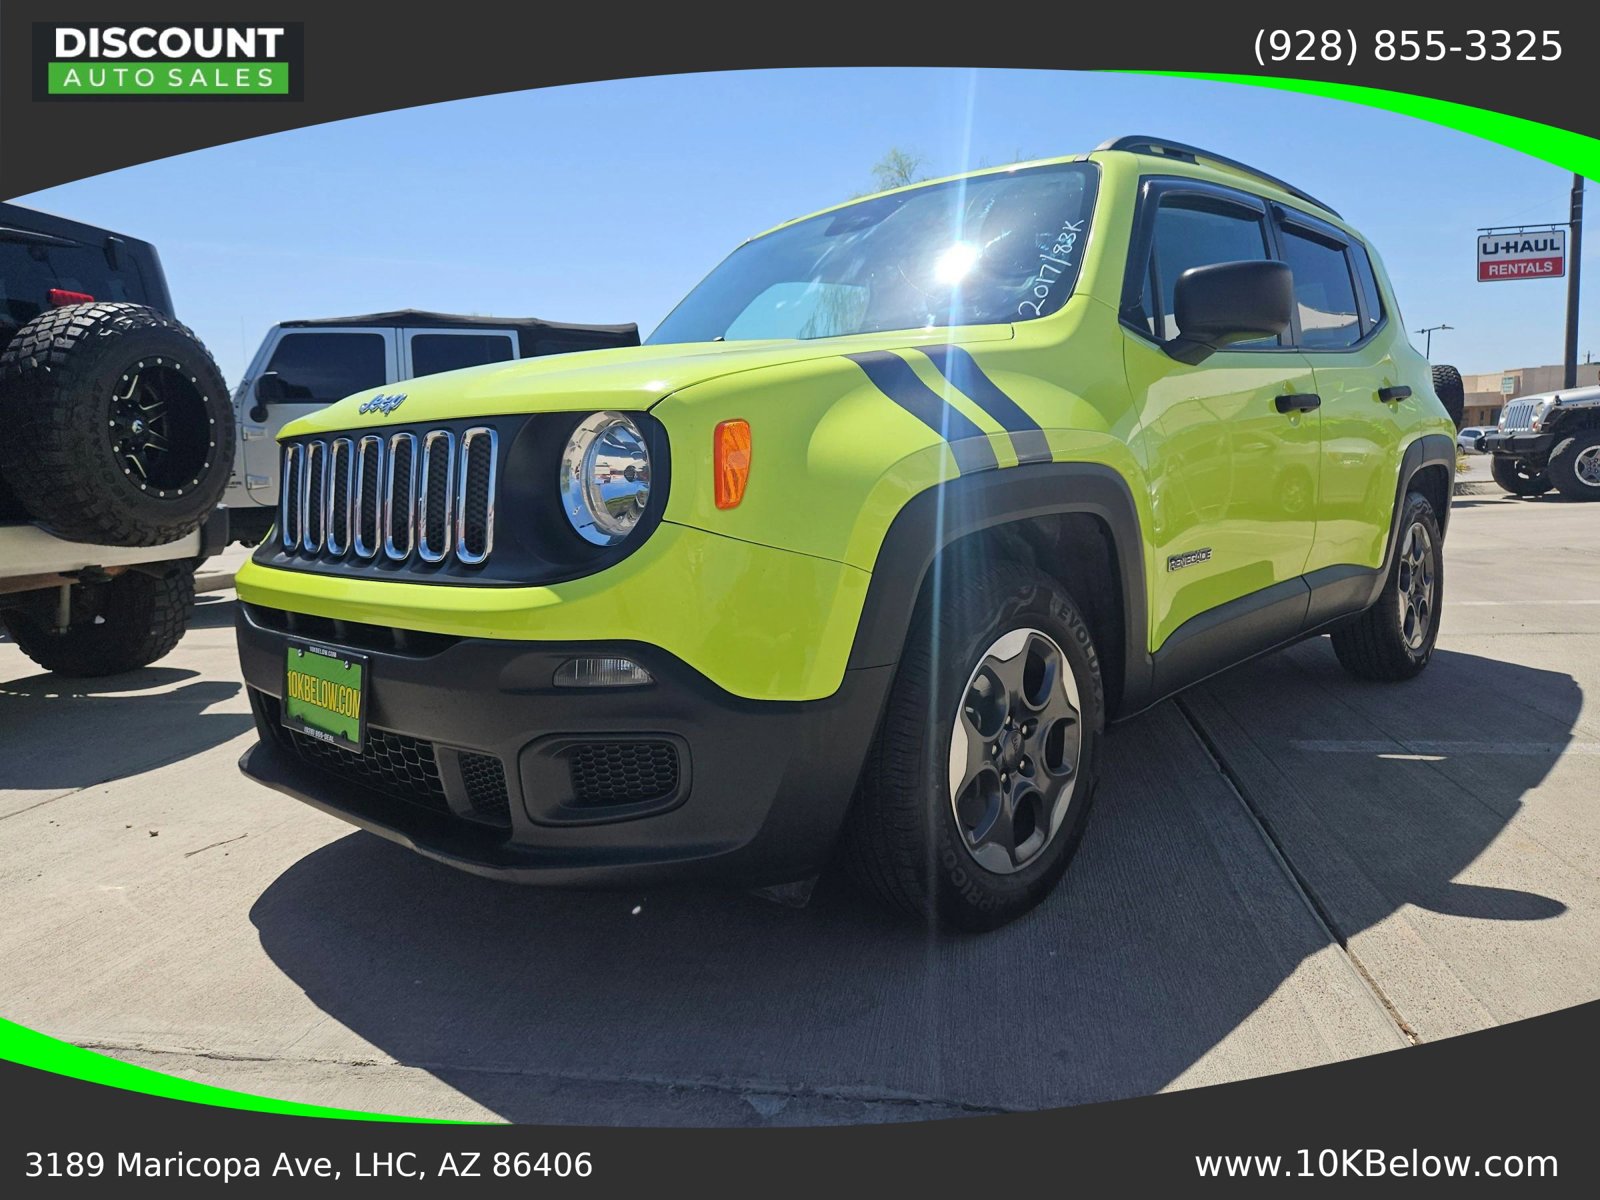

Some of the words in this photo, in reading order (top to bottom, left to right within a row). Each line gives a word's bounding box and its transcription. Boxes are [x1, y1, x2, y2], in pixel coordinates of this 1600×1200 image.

[1482, 238, 1561, 256] U-HAUL
[1488, 261, 1553, 276] RENTALS
[359, 393, 408, 417] Jeep
[1167, 547, 1213, 573] RENEGADE
